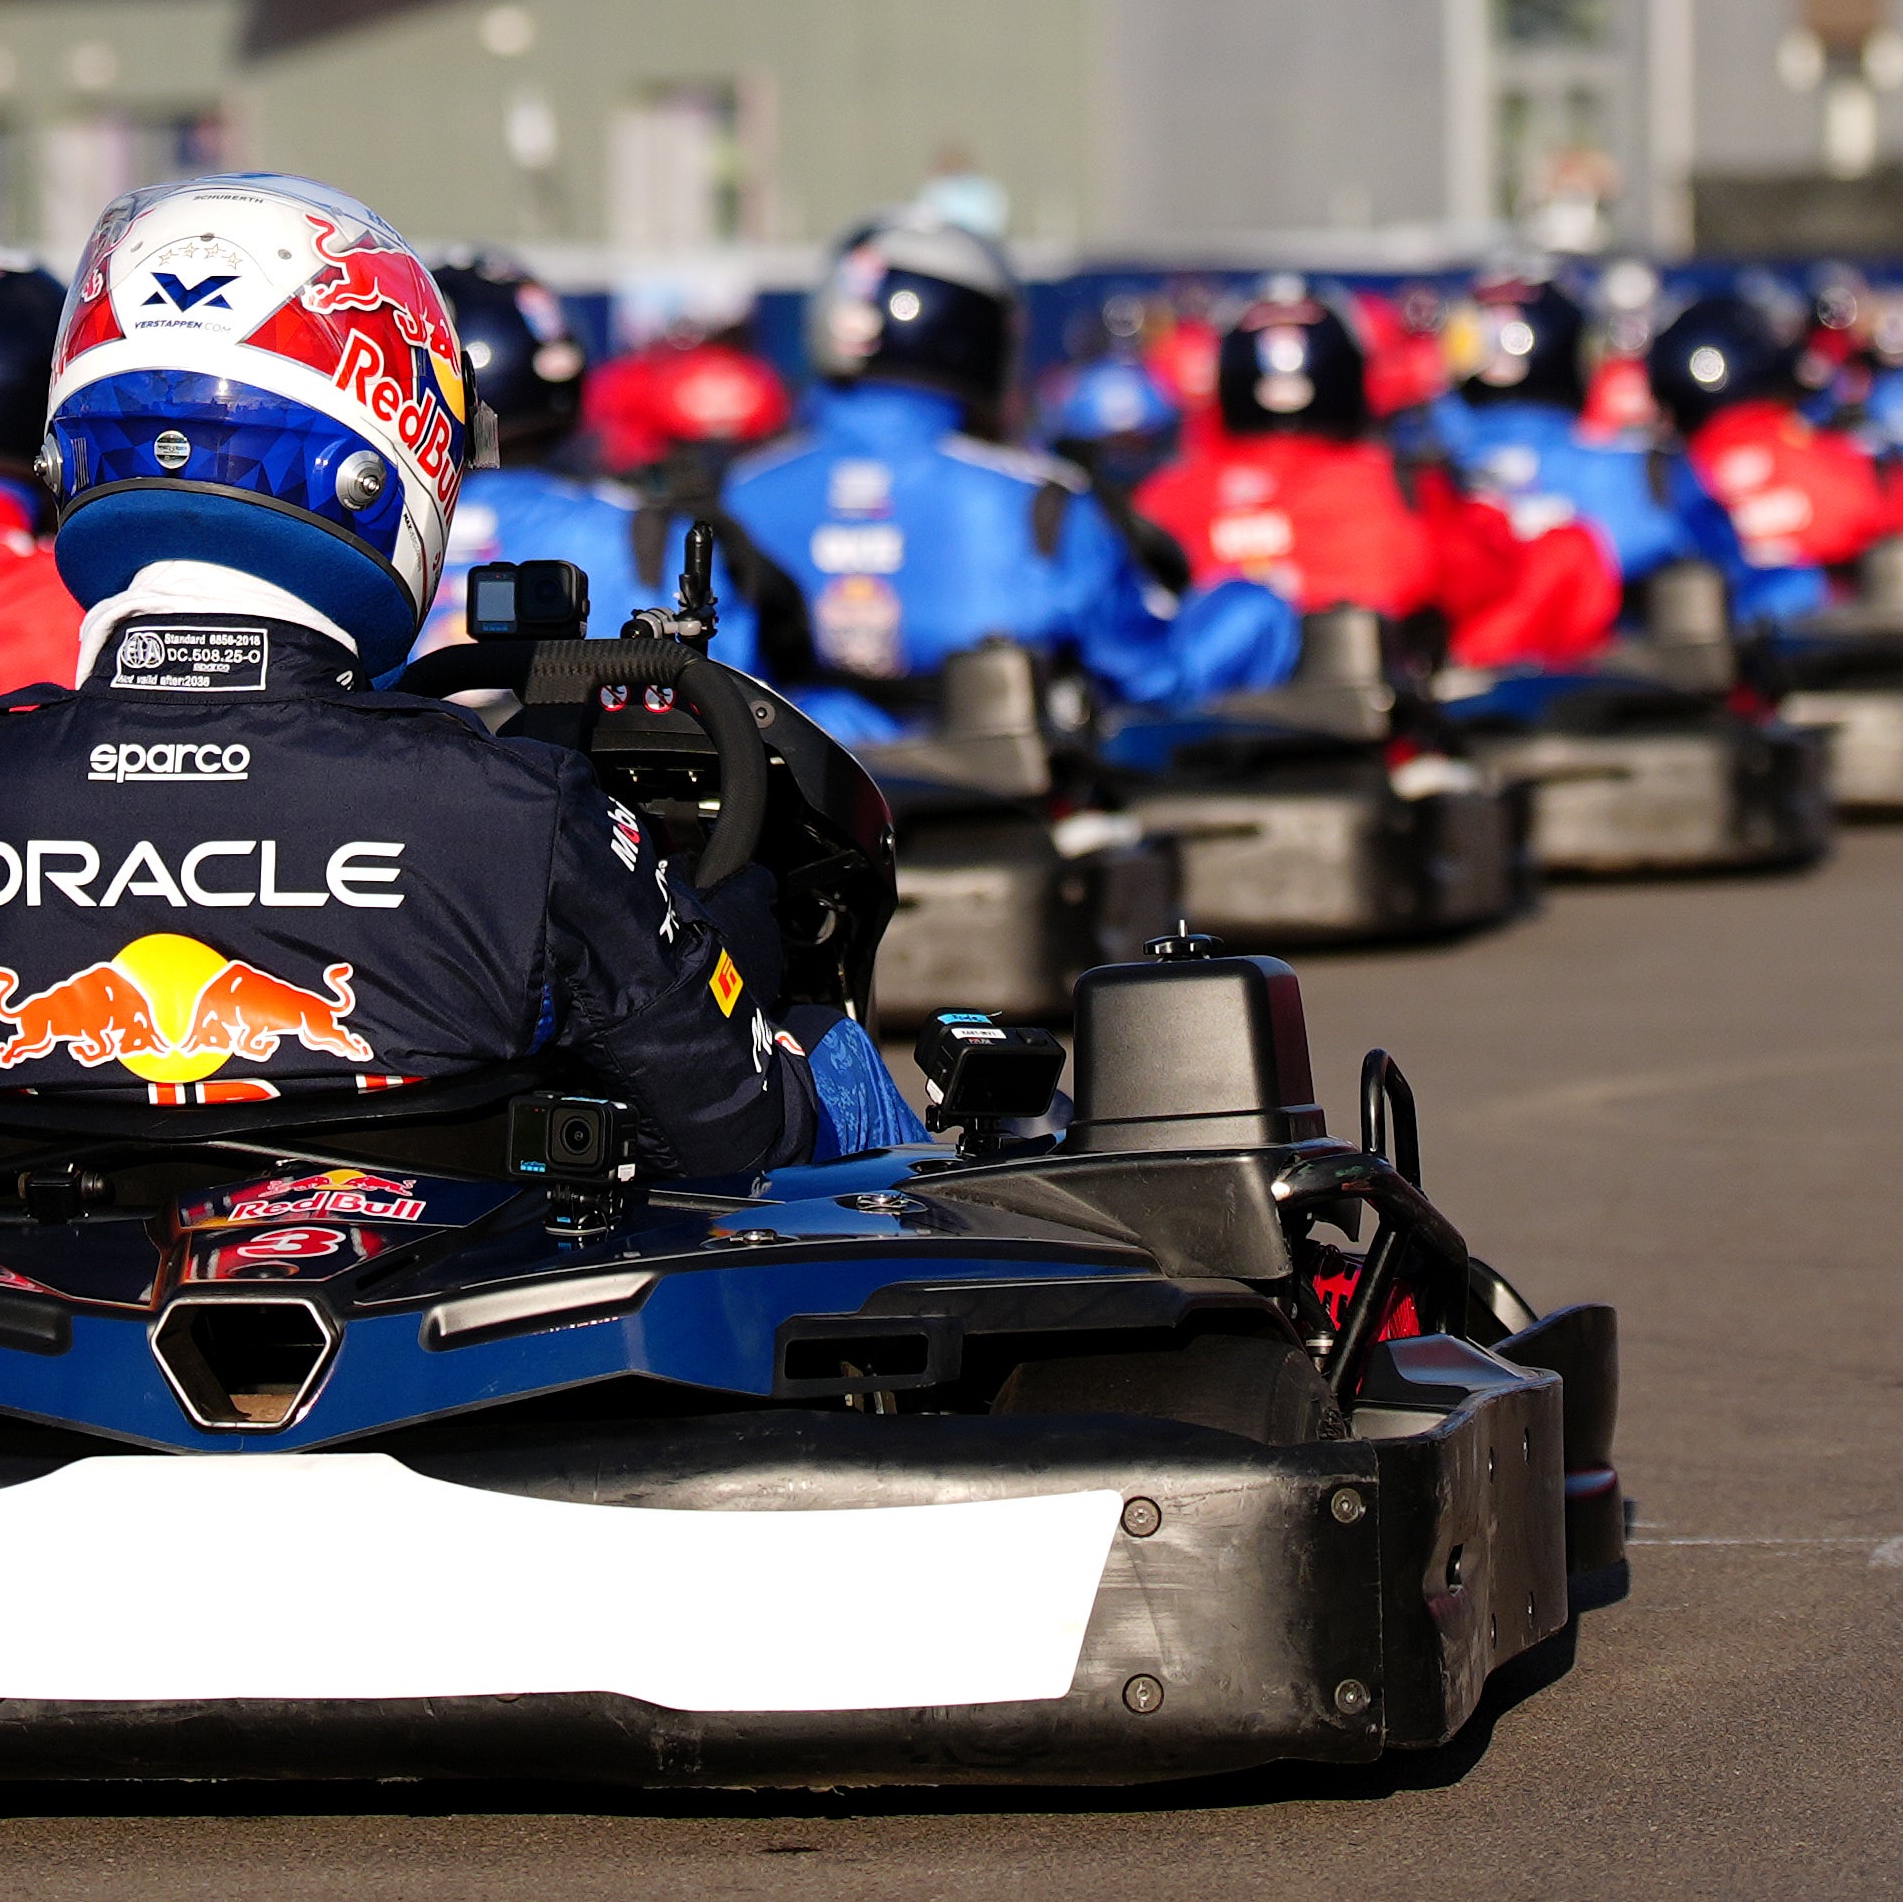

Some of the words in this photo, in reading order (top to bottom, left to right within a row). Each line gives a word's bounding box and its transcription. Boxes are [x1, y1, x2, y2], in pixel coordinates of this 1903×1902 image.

[193, 194, 263, 203] SCHUBERTH
[164, 633, 206, 645] Standard
[88, 743, 250, 783] sparco
[237, 1226, 347, 1259] 3
